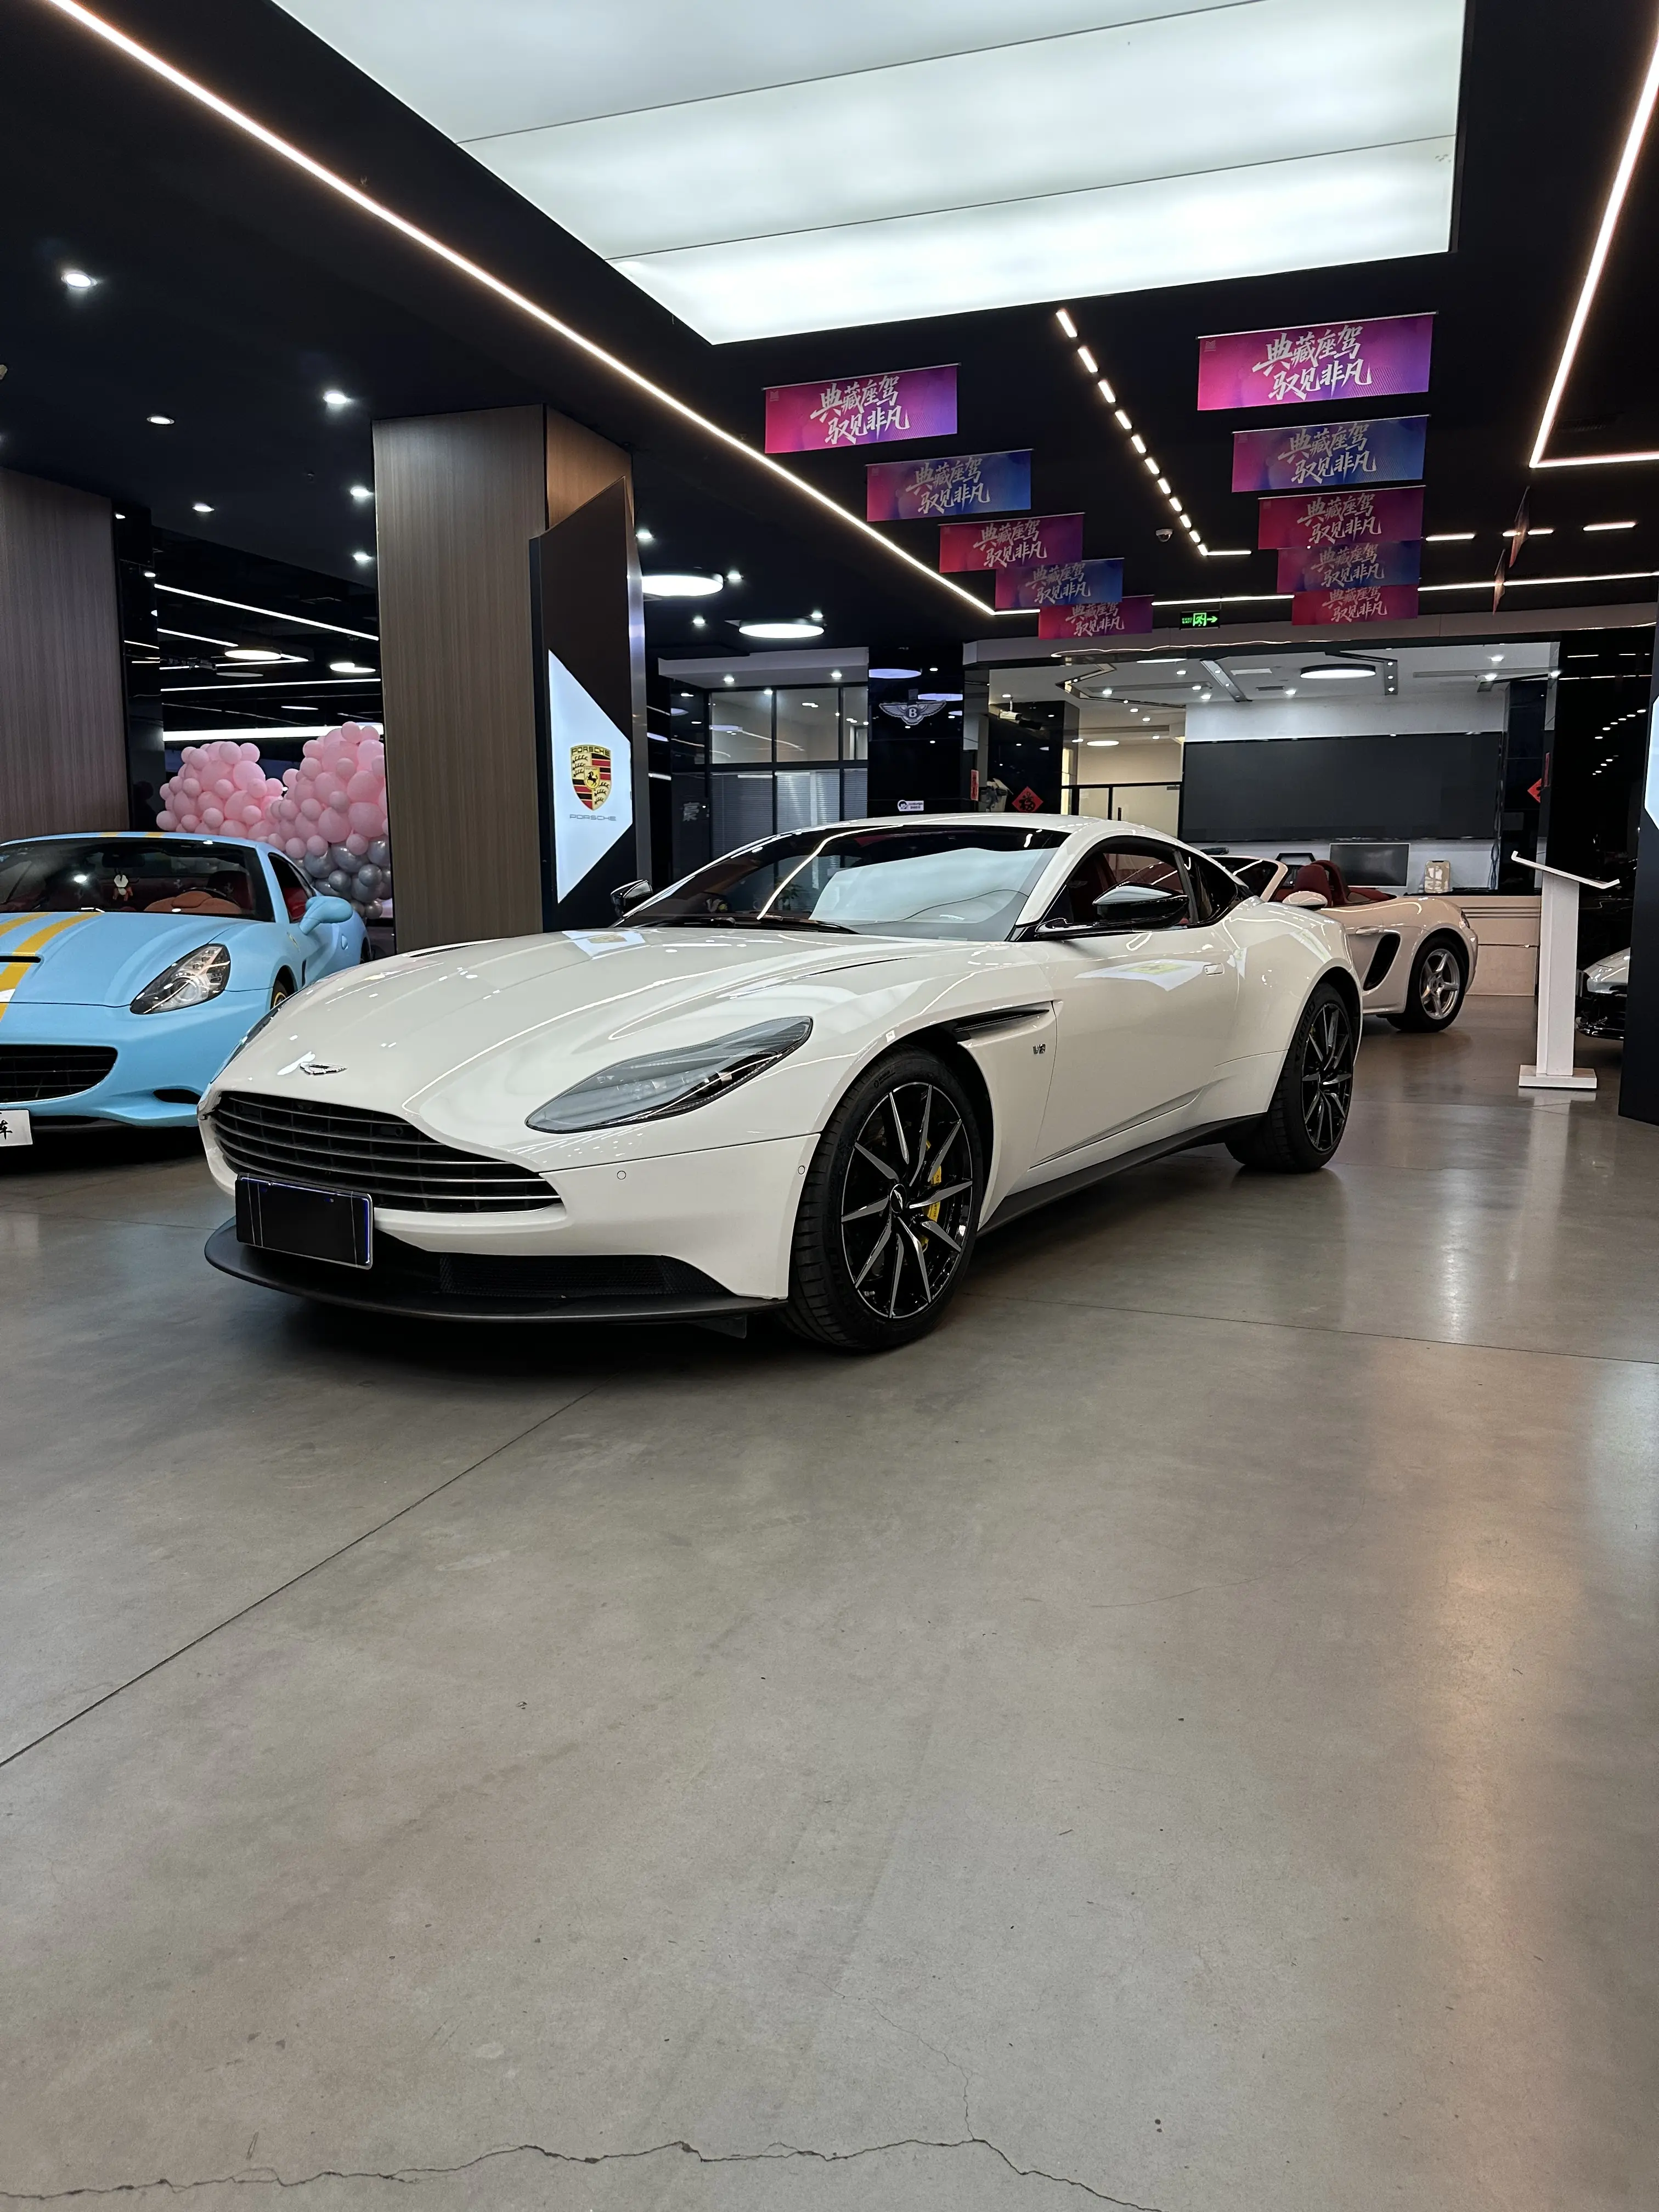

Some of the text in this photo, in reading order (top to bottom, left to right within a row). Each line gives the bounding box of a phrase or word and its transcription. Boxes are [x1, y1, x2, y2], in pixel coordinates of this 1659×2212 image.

[1252, 325, 1363, 377] 典藏座驾
[1268, 359, 1372, 401] 驭见非凡
[810, 375, 900, 423] 典藏座驾
[825, 405, 910, 445] 驭见非凡
[1278, 422, 1370, 464] 典藏座驾
[905, 457, 983, 495] 典藏座驾
[1290, 450, 1376, 484] 驭见非凡
[917, 483, 990, 514] 驭见非凡
[1297, 493, 1375, 527] 典藏座驾
[973, 519, 1040, 551] 典藏座驾
[1308, 516, 1382, 544] 驭见非凡
[983, 541, 1047, 568] 驭见非凡
[1310, 542, 1379, 573] 典藏座驾
[1025, 562, 1086, 589] 典藏座驾
[1321, 563, 1385, 588] 驭见非凡
[1034, 582, 1091, 604] 驭见非凡
[1322, 586, 1381, 610] 典藏座驾
[1073, 616, 1125, 636] 驭见非凡
[1331, 601, 1387, 623] 驭见非凡
[909, 708, 917, 718] B
[572, 746, 610, 757] PORSCHE
